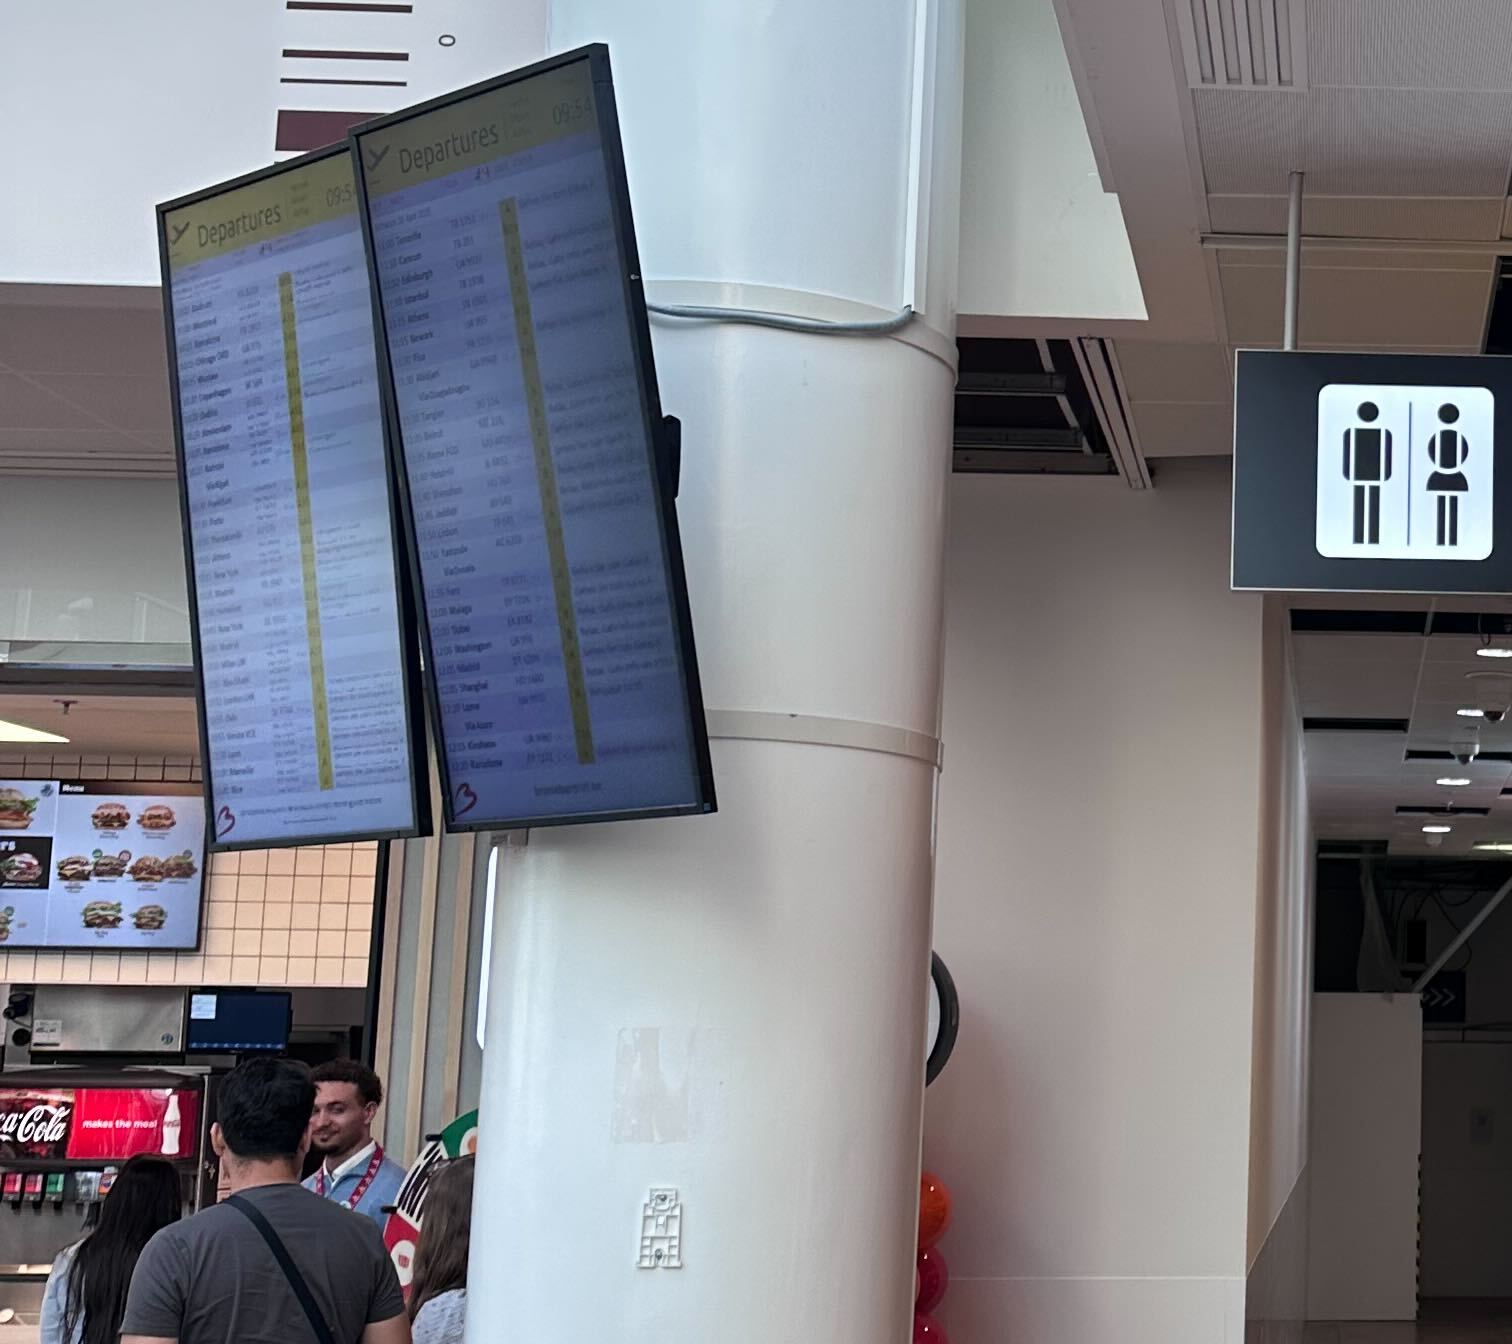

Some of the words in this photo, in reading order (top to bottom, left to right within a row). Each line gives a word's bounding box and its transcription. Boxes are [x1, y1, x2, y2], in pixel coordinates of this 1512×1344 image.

[400, 123, 499, 174] Departures
[553, 97, 592, 124] 09:54
[197, 205, 281, 247] Departures
[82, 1119, 113, 1129] makes
[115, 1119, 131, 1129] the
[133, 1119, 158, 1129] meal
